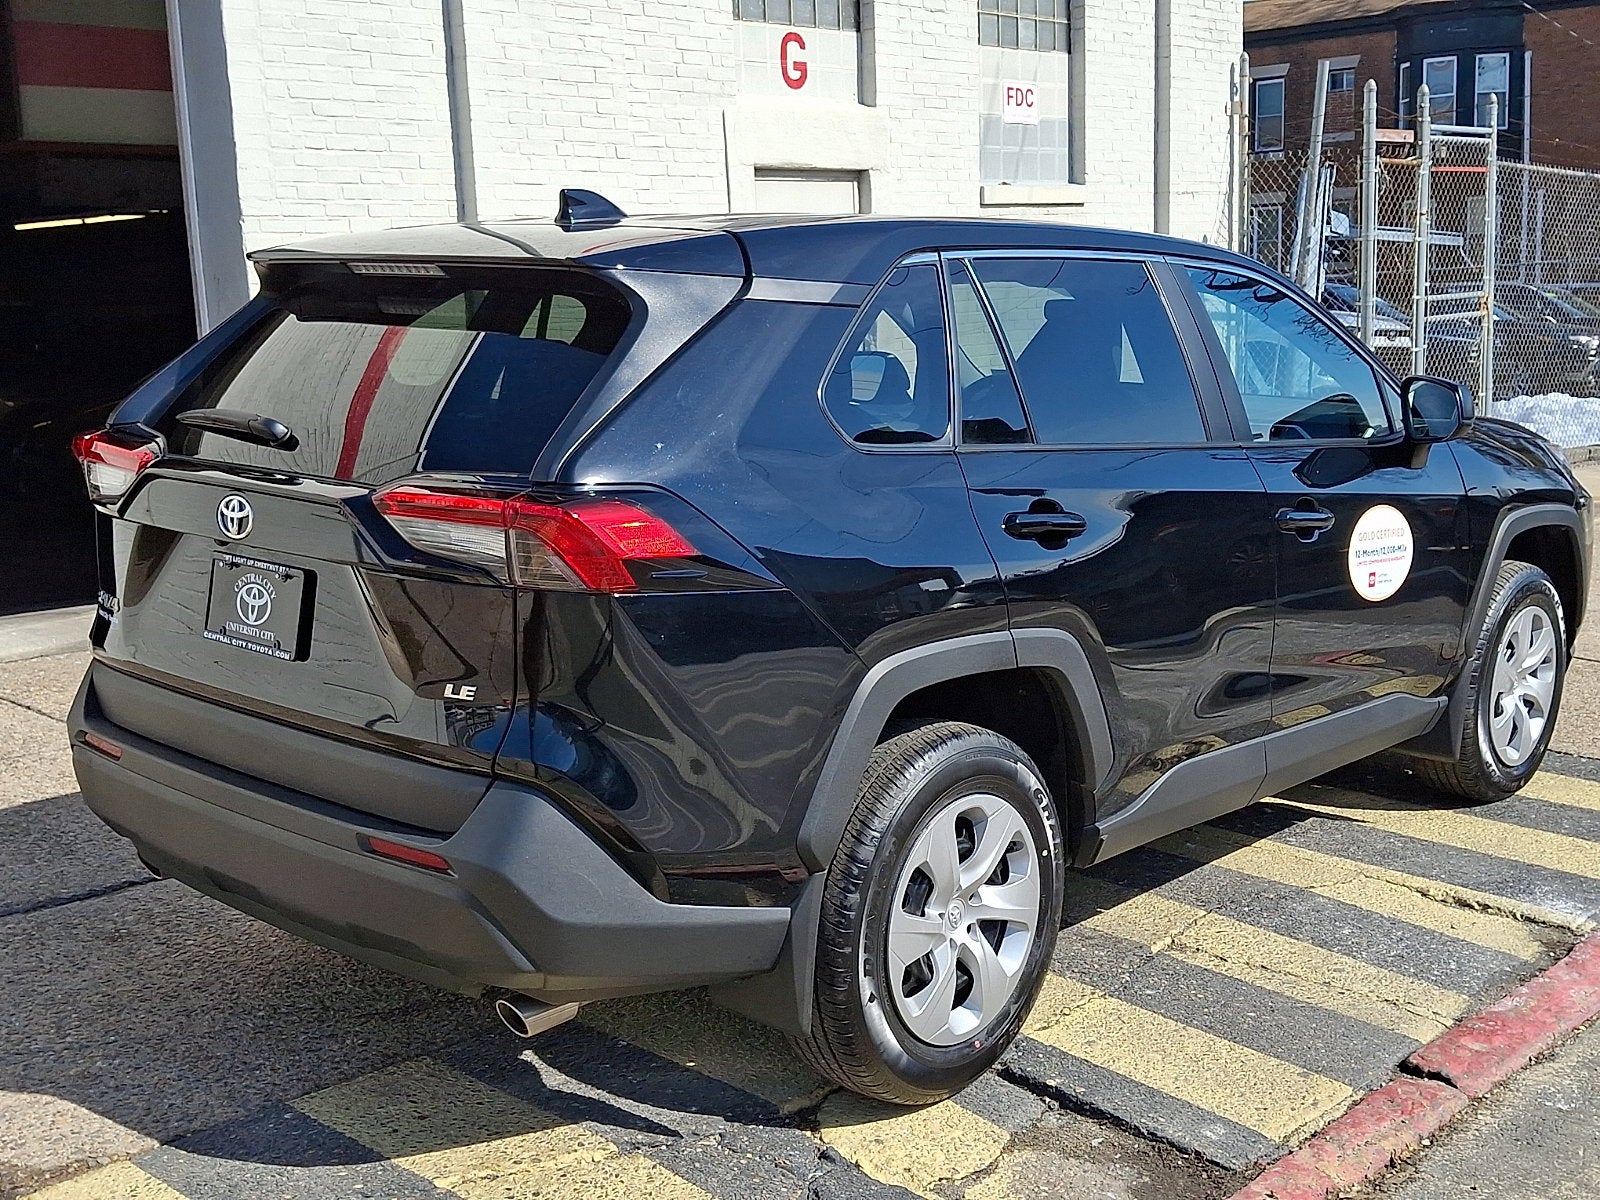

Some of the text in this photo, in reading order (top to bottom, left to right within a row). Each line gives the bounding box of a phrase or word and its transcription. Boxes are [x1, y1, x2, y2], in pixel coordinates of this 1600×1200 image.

[780, 32, 807, 89] G
[1006, 86, 1034, 108] FDC
[1358, 531, 1375, 541] GOLD
[234, 573, 277, 599] CENTRAL CITY
[203, 631, 231, 644] CENTRAL
[232, 638, 247, 648] CITY
[225, 621, 275, 642] UNIVERSITY CITY
[443, 683, 478, 701] LE
